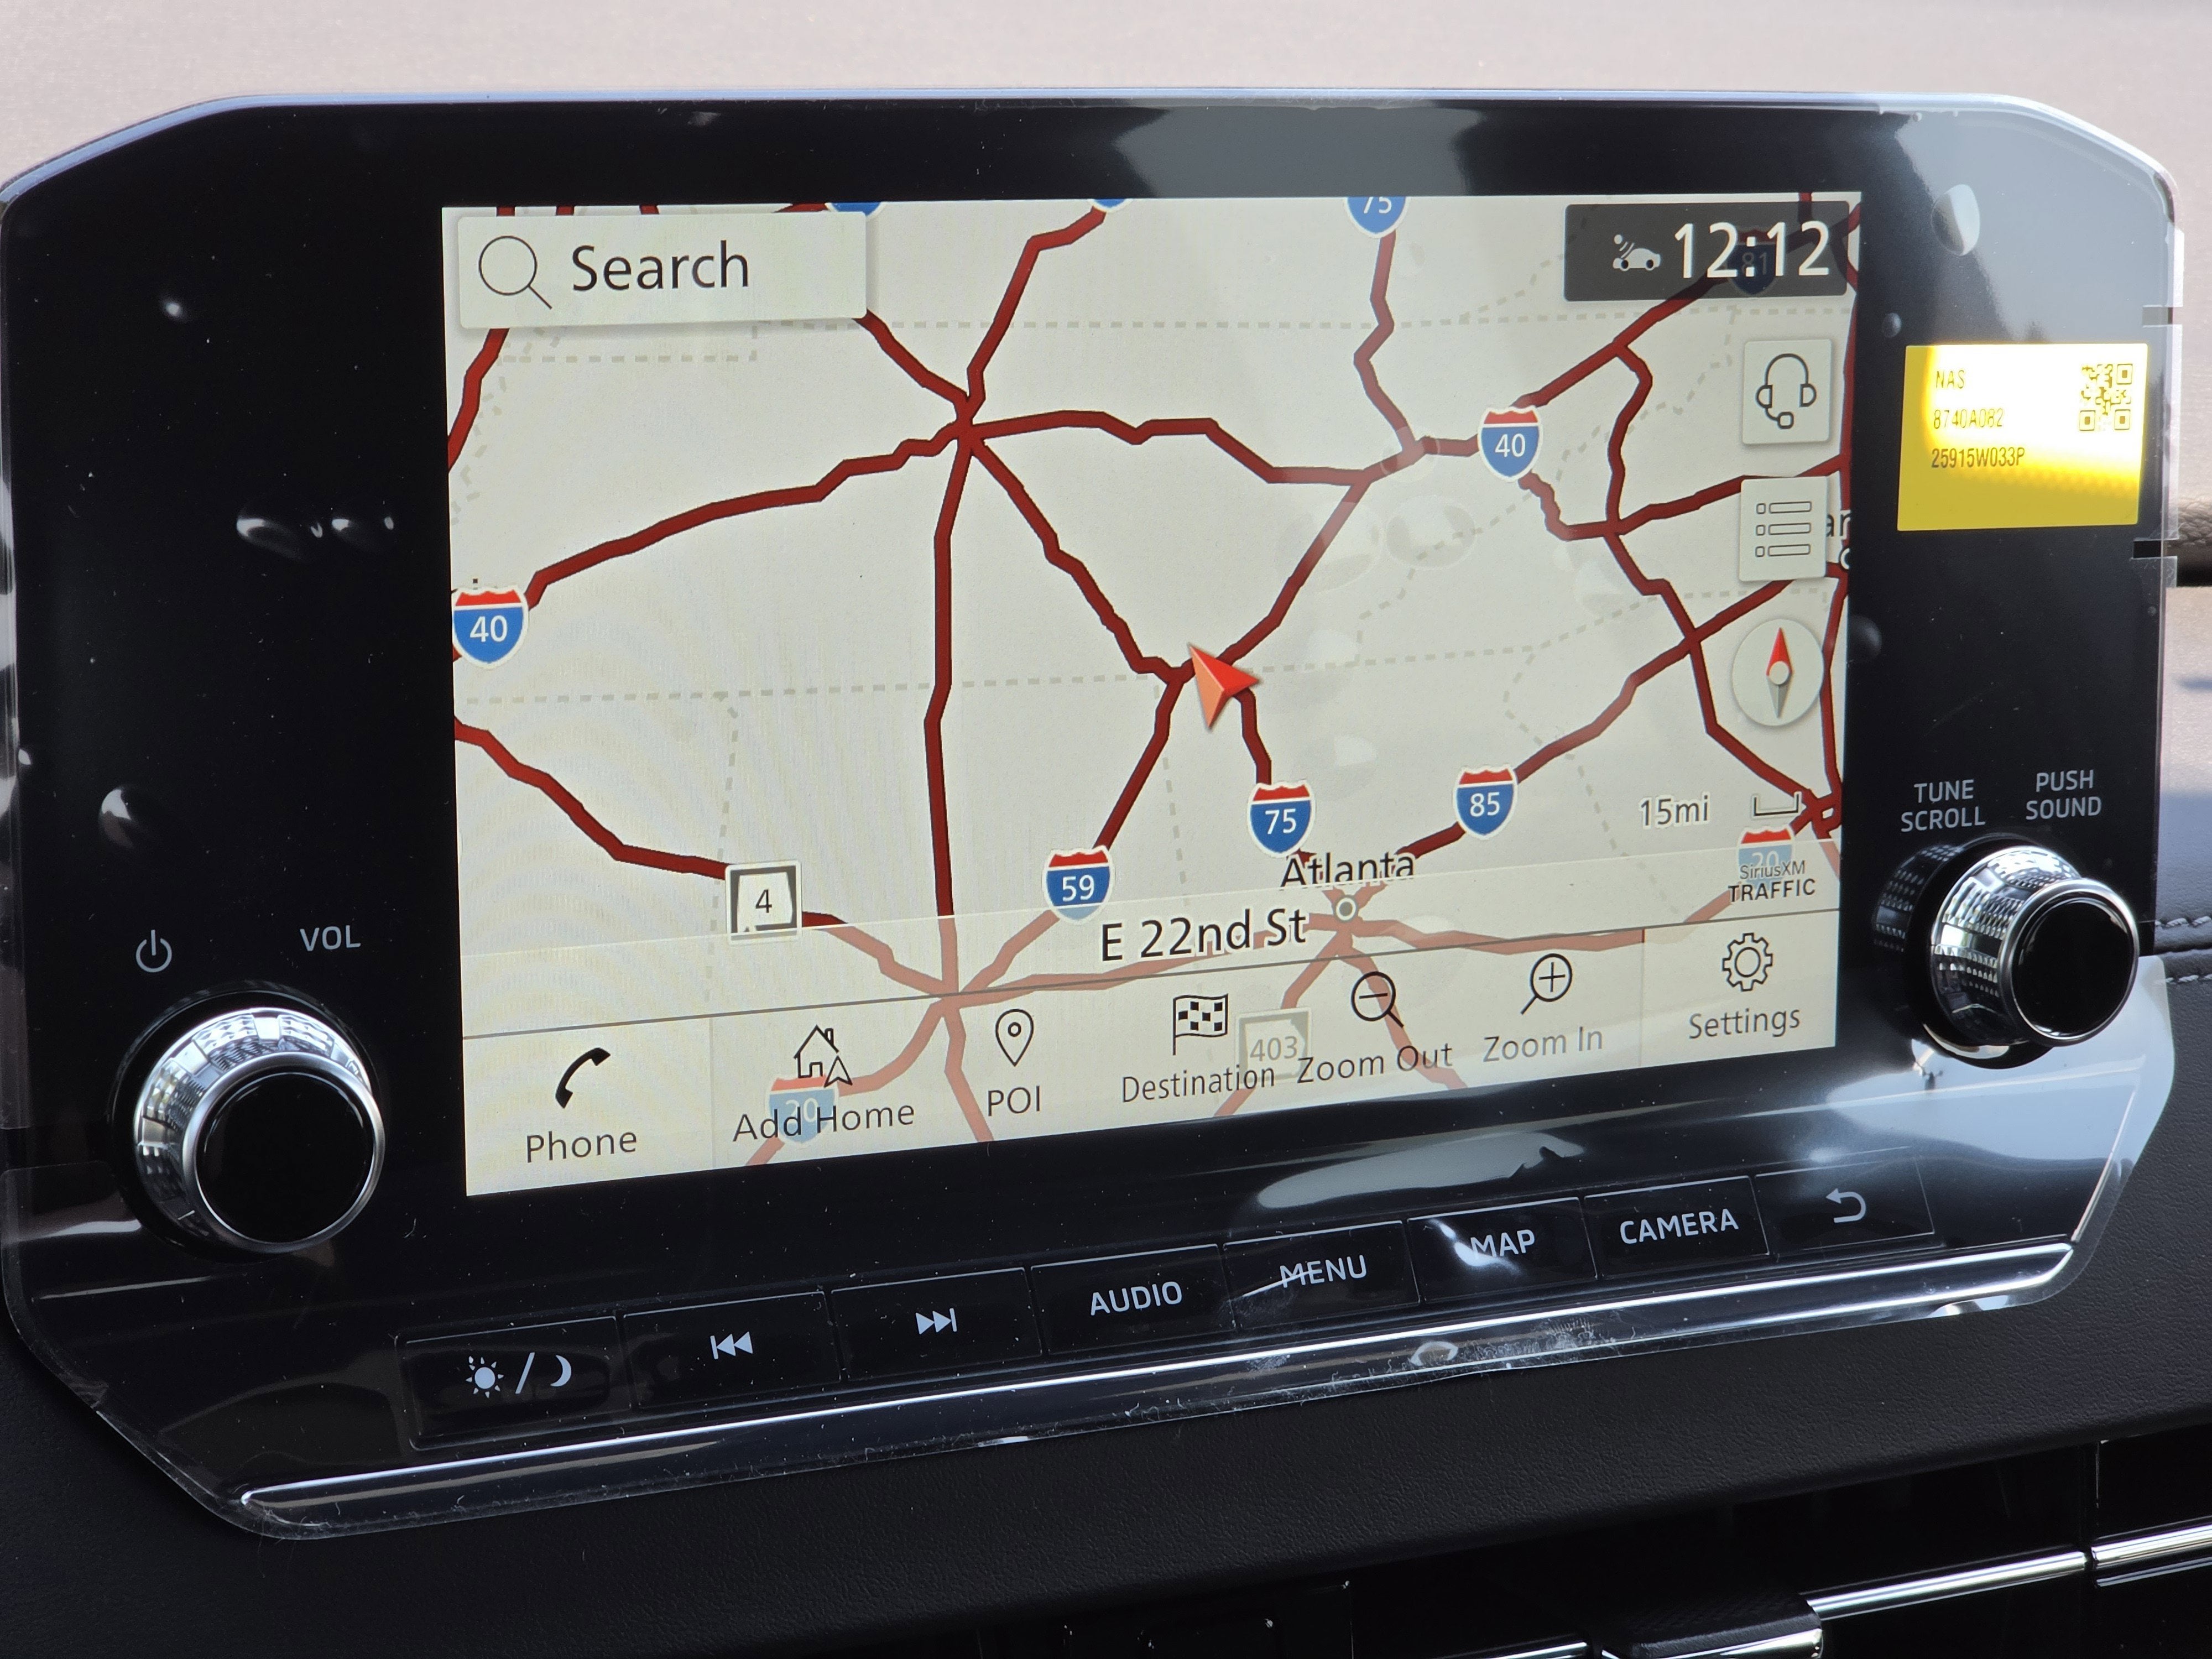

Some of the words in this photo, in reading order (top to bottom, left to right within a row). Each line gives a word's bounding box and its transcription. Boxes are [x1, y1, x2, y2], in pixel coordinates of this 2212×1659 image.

[1674, 221, 1830, 278] 12:12
[571, 240, 750, 293] Search
[1936, 369, 1965, 389] NAS
[1933, 408, 2004, 429] 8740A082
[1494, 433, 1526, 458] 40
[1932, 447, 2025, 468] 25915W033P
[469, 615, 508, 643] 40
[1914, 779, 1974, 803] TUNE
[2036, 769, 2094, 792] PUSH
[1469, 792, 1500, 817] 85
[1640, 795, 1709, 826] 15mi
[2026, 796, 2101, 820] SOUND
[1265, 808, 1297, 834] 75
[1901, 806, 1986, 832] SCROLL
[1280, 852, 1414, 888] Atlanta
[1740, 859, 1806, 880] SiriusXM
[755, 888, 773, 914] 4
[1061, 875, 1095, 902] 59
[1728, 878, 1815, 902] TRAFFIC
[300, 925, 361, 951] VOL
[1102, 923, 1123, 962] E
[1140, 909, 1251, 958] 22nd
[1267, 909, 1306, 946] St
[1689, 1008, 1801, 1040] Settings
[1250, 1035, 1297, 1062] 403
[1483, 1034, 1567, 1063] Zoom
[1578, 1026, 1603, 1052] In
[1297, 1055, 1385, 1084] Zoom
[1397, 1042, 1453, 1070] Out
[1123, 1065, 1275, 1103] Destination
[988, 1085, 1041, 1117] POI
[733, 1107, 801, 1141] Add
[817, 1104, 915, 1133] Home
[526, 1131, 637, 1163] Phone
[1620, 1208, 1739, 1245] CAMERA
[1470, 1228, 1536, 1261] MAP
[1279, 1254, 1368, 1288] MENU
[1091, 1281, 1183, 1316] AUDIO
